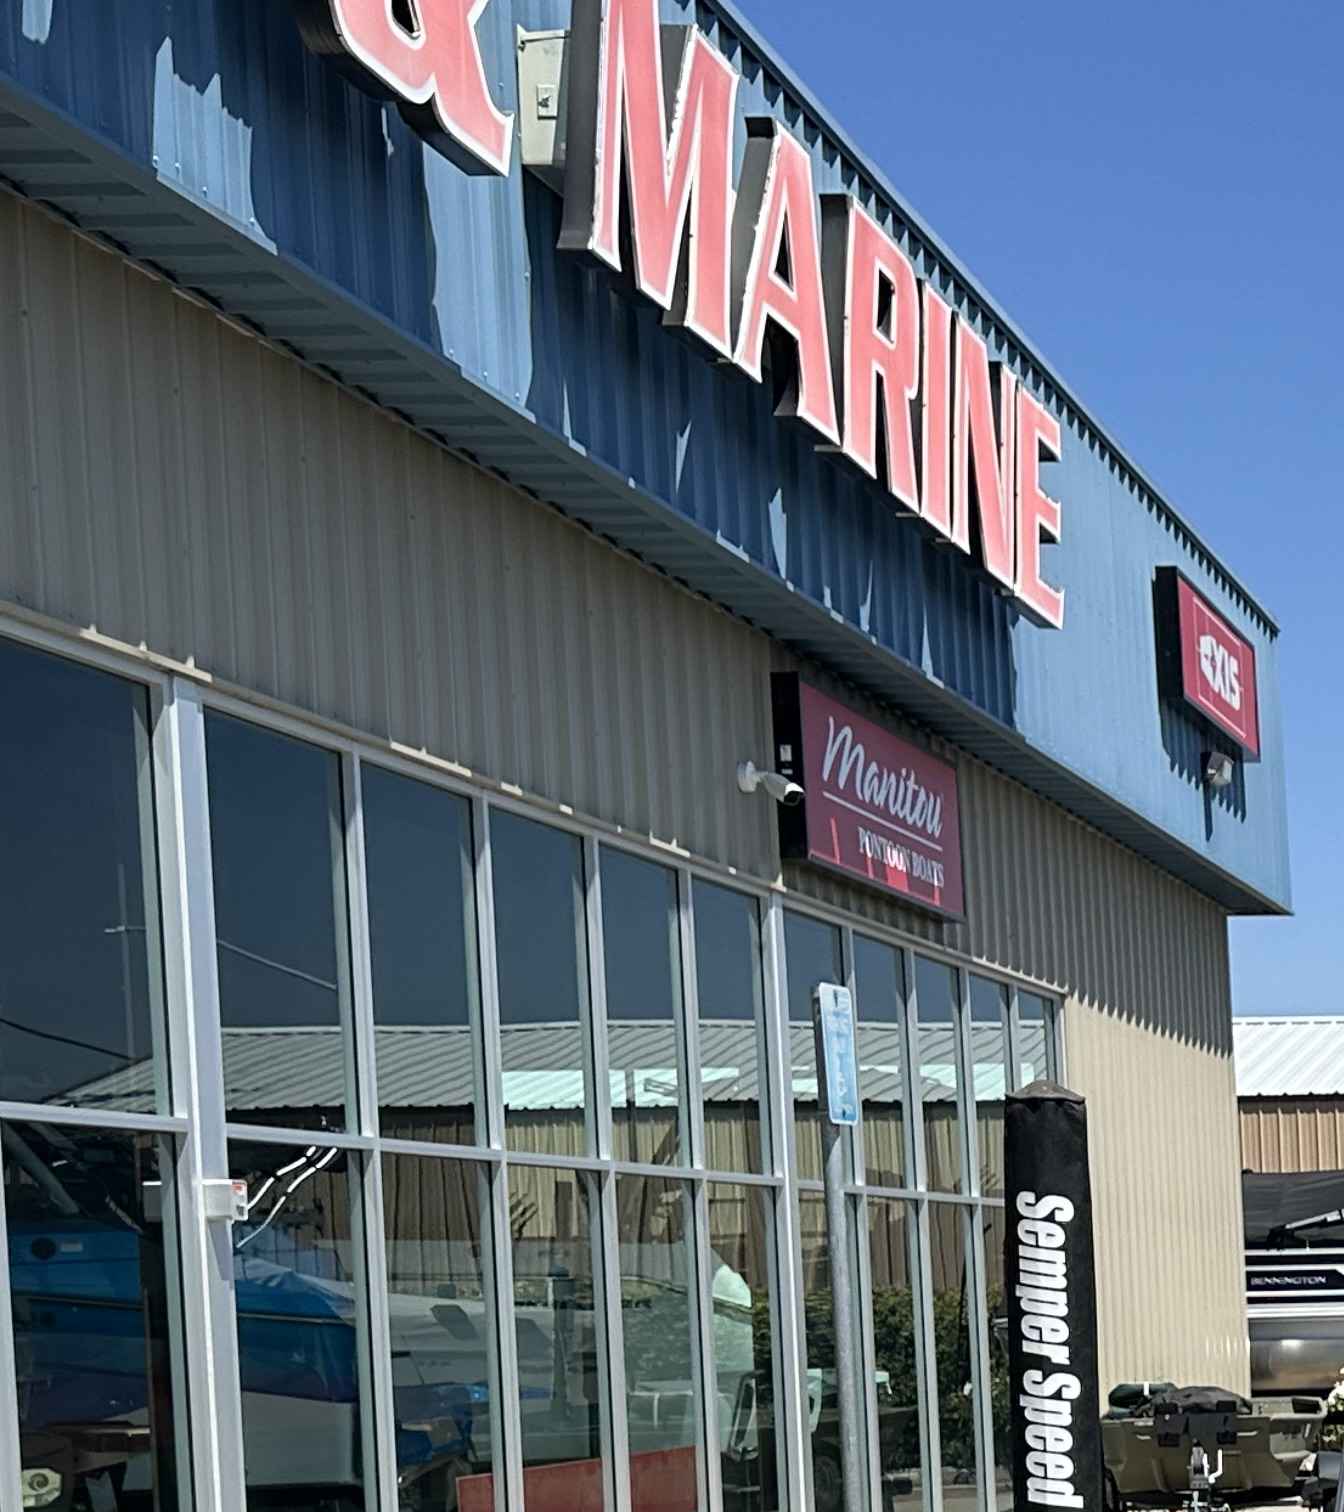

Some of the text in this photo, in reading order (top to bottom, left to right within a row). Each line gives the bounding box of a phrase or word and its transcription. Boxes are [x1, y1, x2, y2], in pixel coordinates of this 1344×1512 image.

[590, 0, 1064, 630] MARINE
[822, 715, 943, 838] Manitou
[858, 826, 944, 887] PONTOON BOATS
[1015, 1190, 1075, 1365] Semper
[1250, 1275, 1327, 1286] BENNINGTON
[1019, 1368, 1084, 1508] Speed
